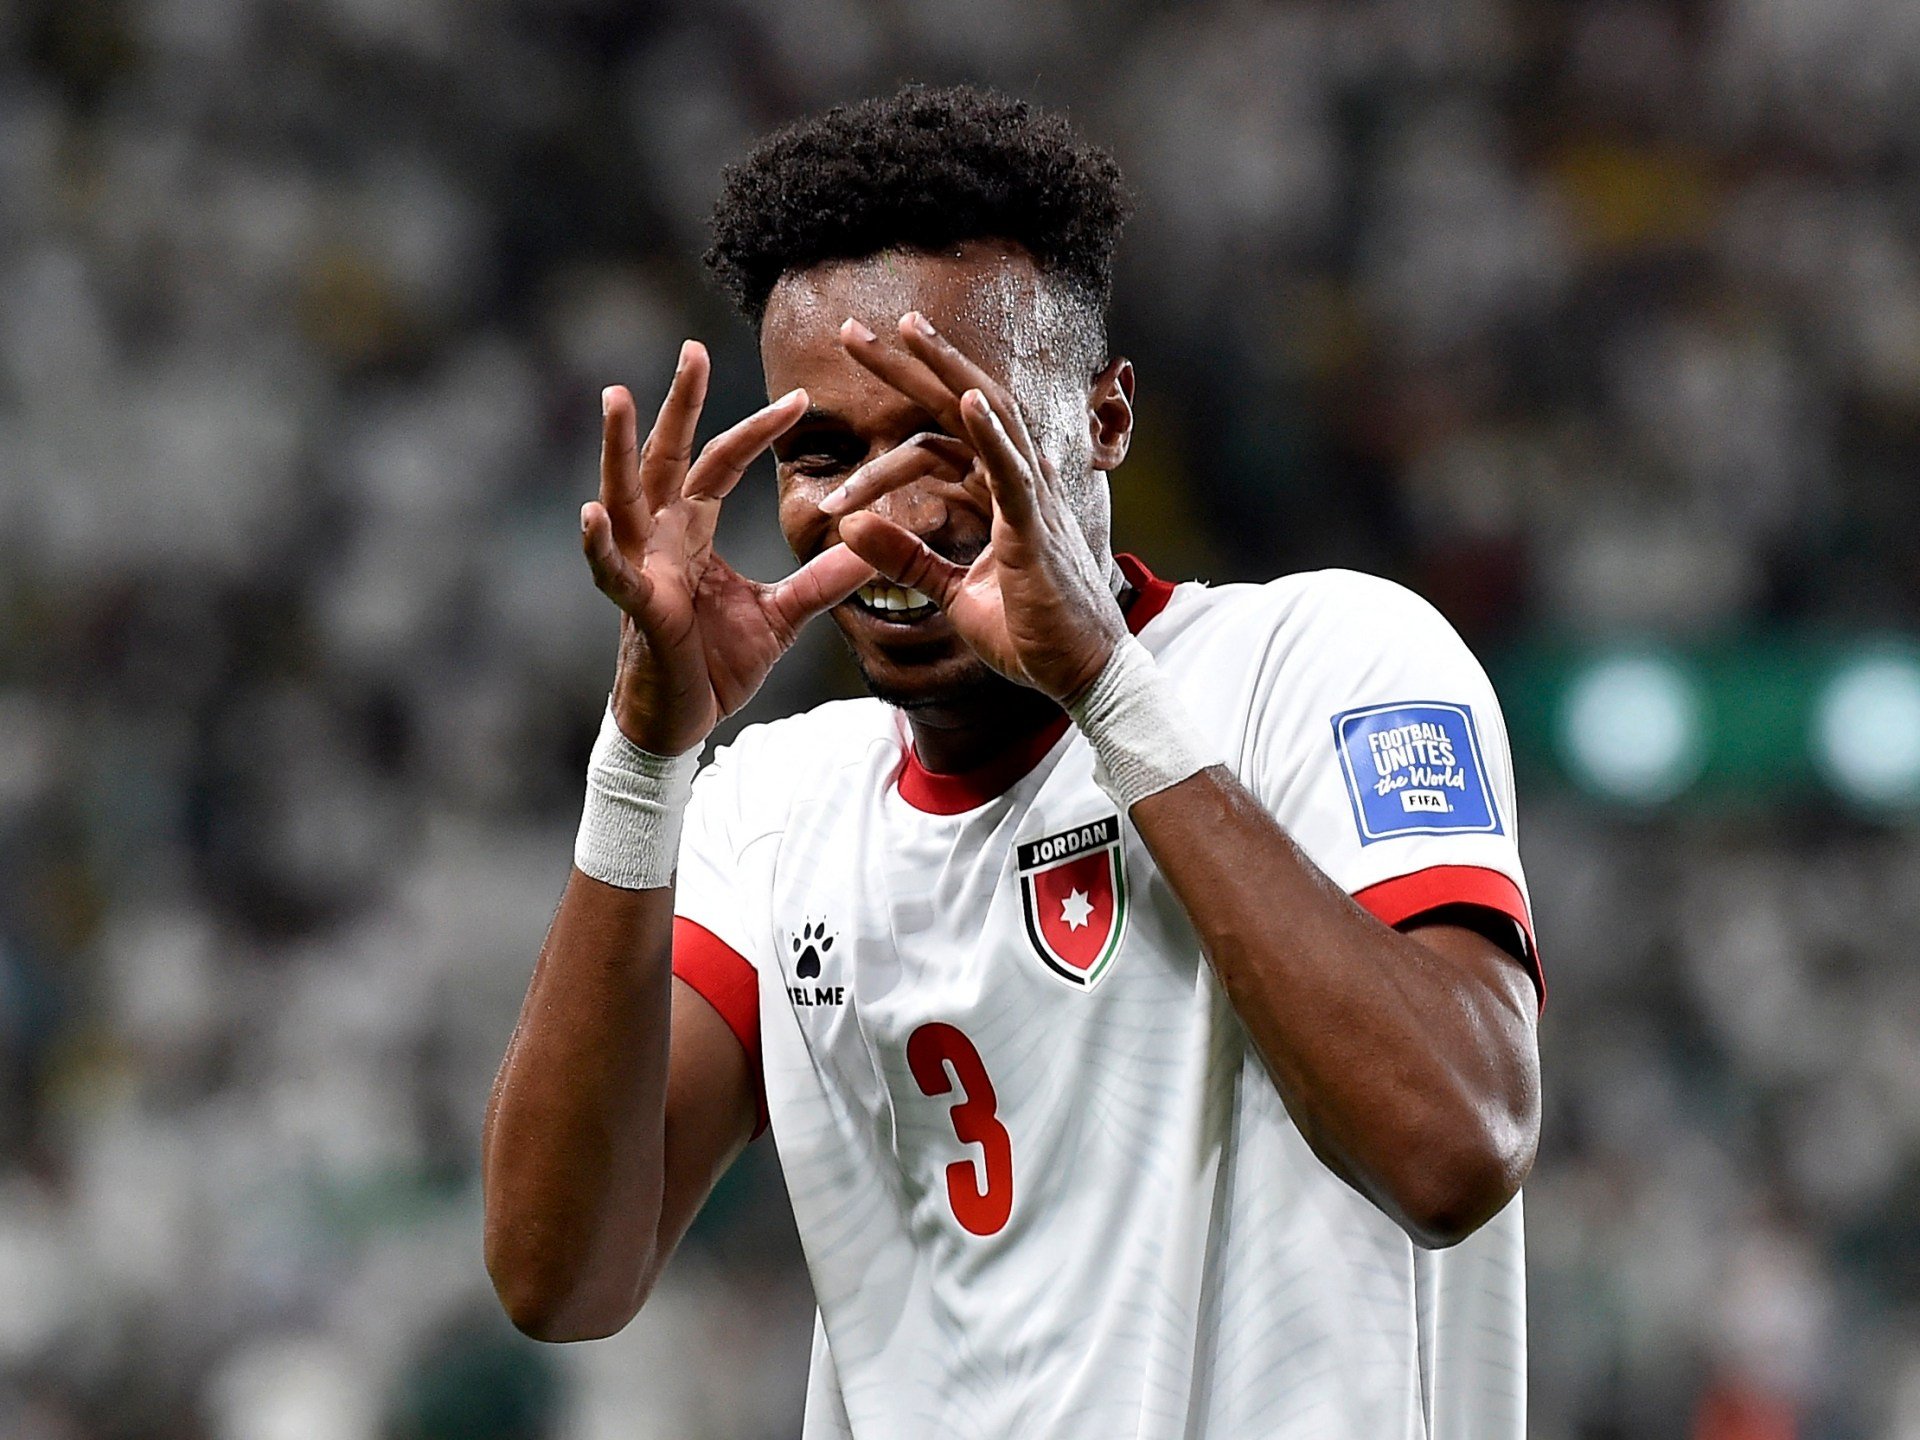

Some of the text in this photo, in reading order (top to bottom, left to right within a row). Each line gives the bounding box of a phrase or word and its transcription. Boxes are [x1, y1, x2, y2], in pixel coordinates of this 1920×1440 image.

[1368, 722, 1450, 752] FOOTBALL
[1373, 741, 1456, 776] UNITES
[1374, 766, 1465, 796] the World
[1408, 795, 1441, 807] FIFA
[1032, 822, 1108, 865] JORDAN
[906, 1022, 1014, 1236] 3
